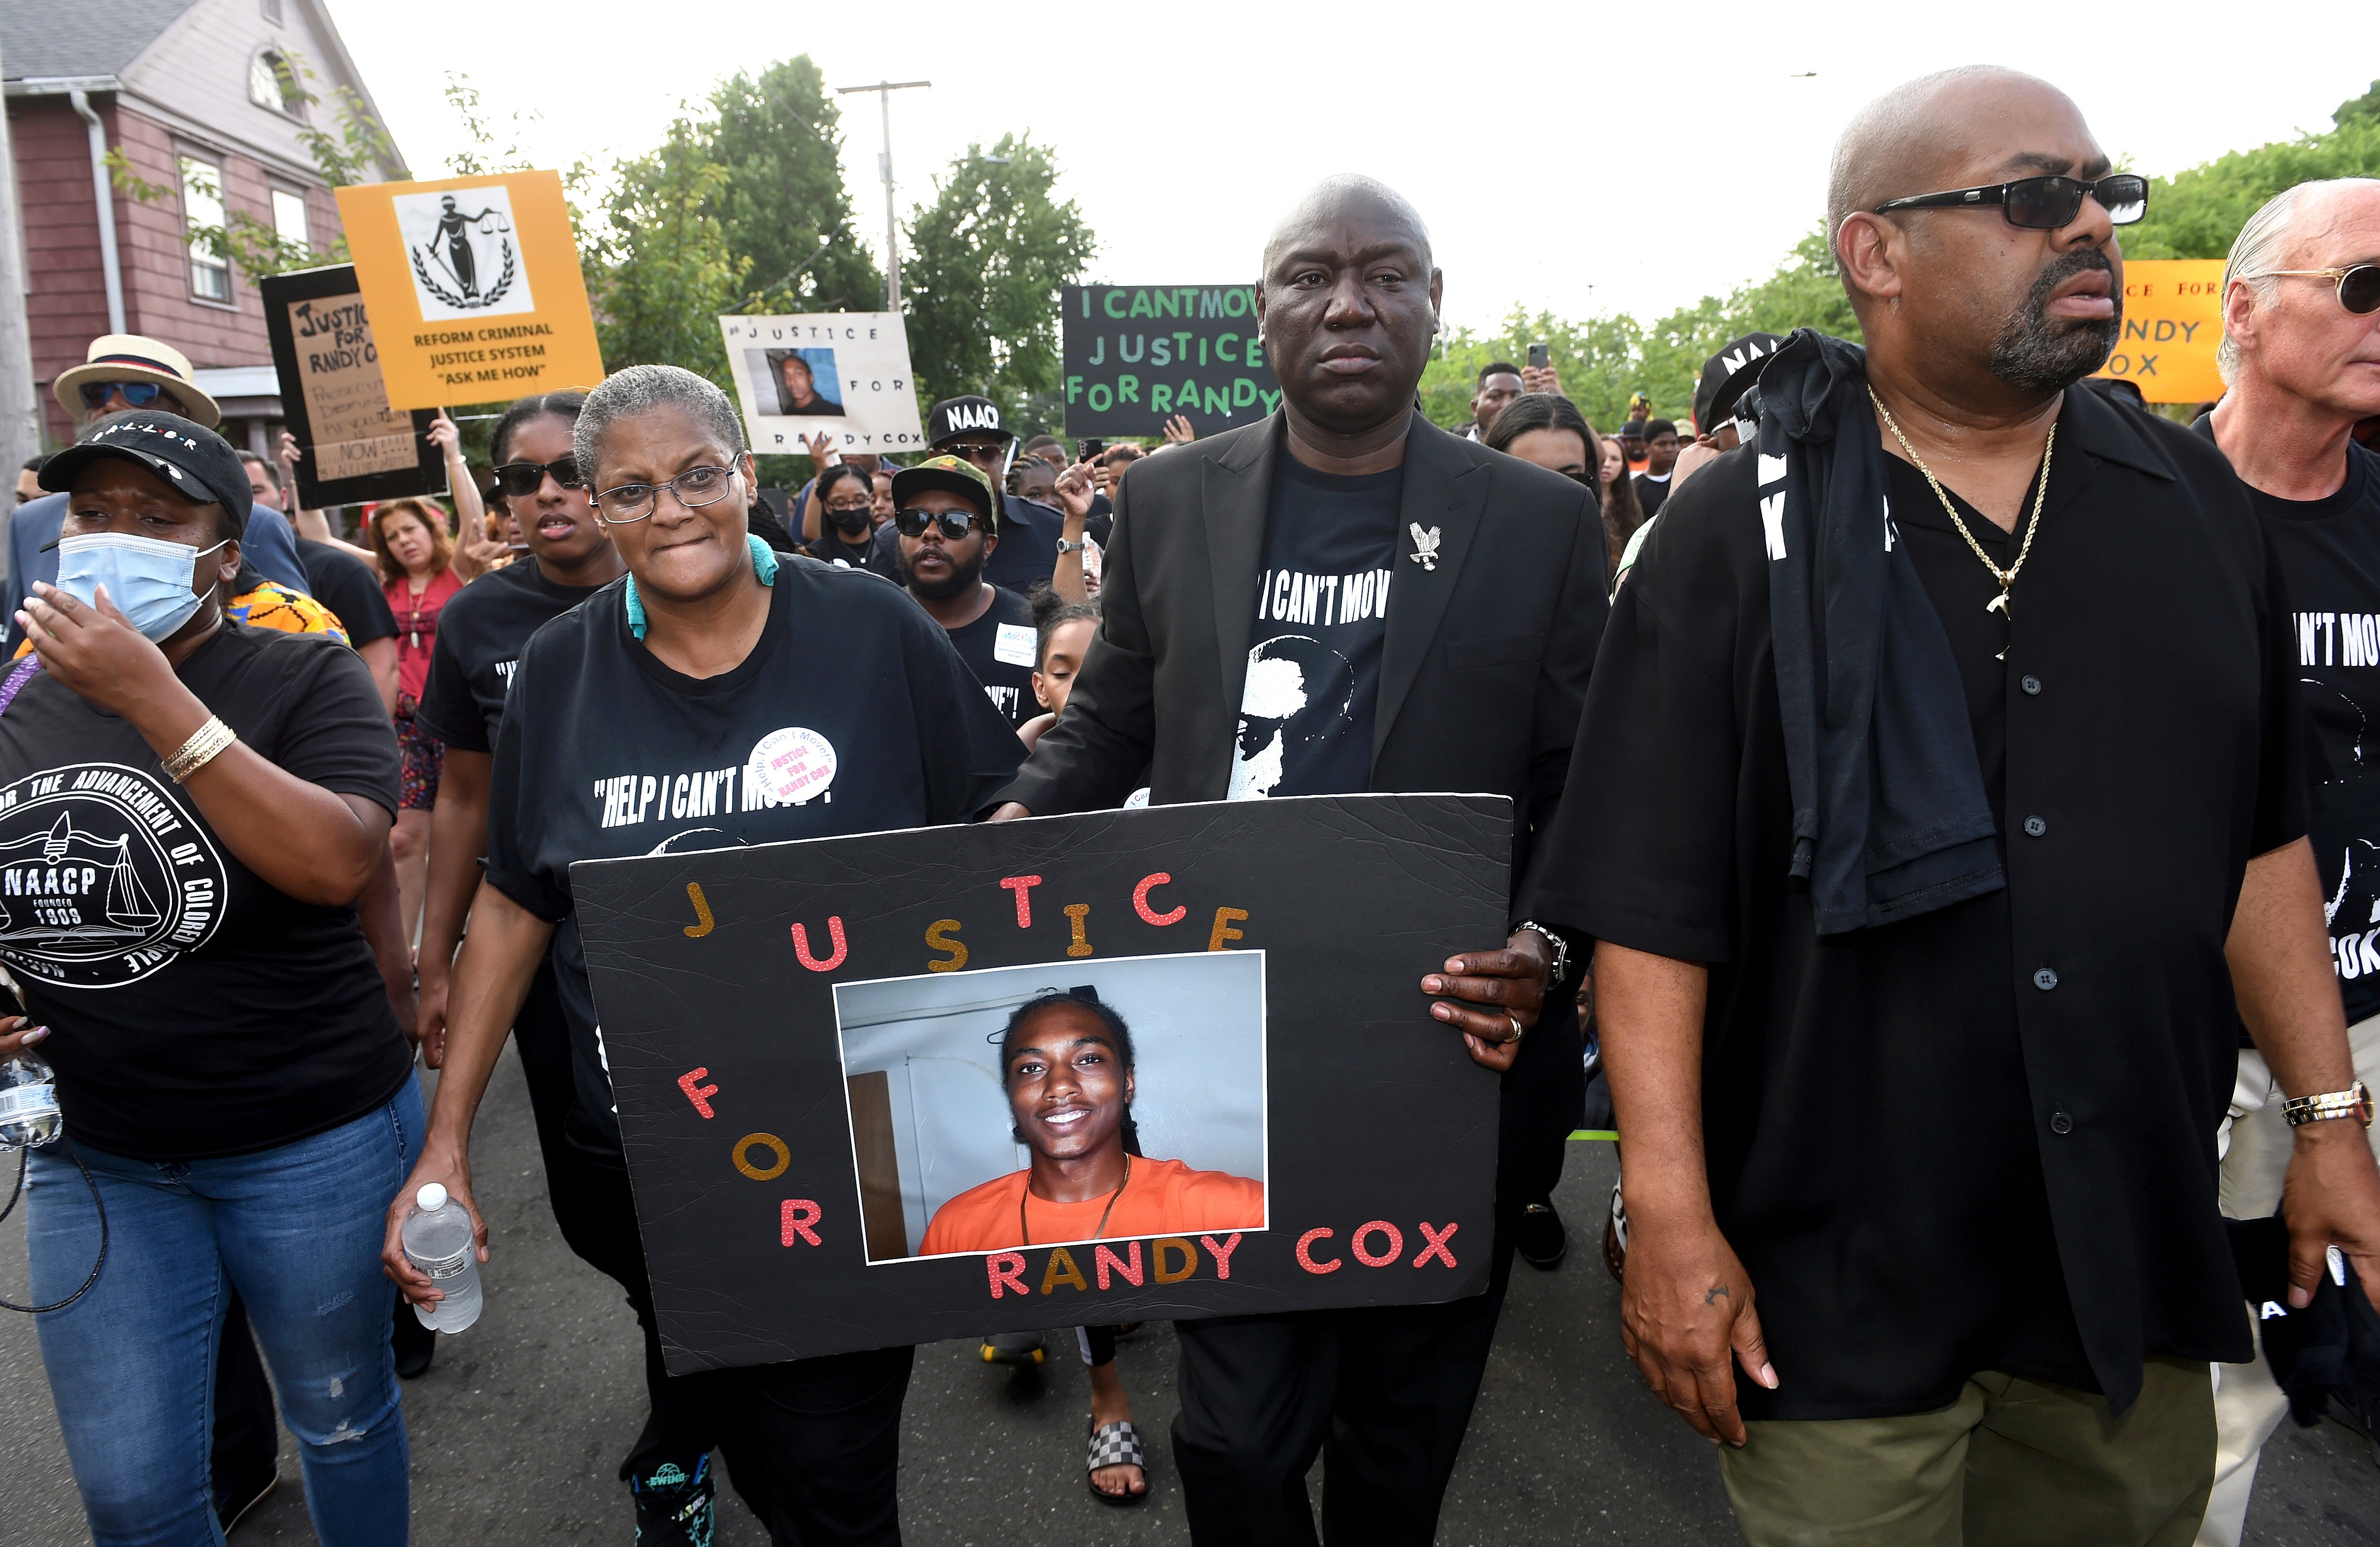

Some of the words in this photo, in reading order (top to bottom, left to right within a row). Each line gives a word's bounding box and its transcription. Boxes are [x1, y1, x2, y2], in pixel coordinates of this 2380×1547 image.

[2178, 282, 2217, 295] FOR
[1082, 290, 1091, 319] I
[334, 327, 365, 348] FOR
[413, 326, 474, 348] REFORM
[477, 323, 554, 341] CRIMINAL
[2125, 319, 2200, 343] NDY
[309, 347, 362, 374] RANDY
[429, 349, 486, 369] JUSTICE
[489, 344, 546, 361] SYSTEM
[1088, 331, 1263, 367] JUSTICE
[438, 369, 473, 386] "ASK
[477, 366, 499, 381] ME
[503, 364, 547, 381] HOW"
[2109, 354, 2159, 376] OX
[850, 380, 904, 391] FOR
[1066, 374, 1139, 412] FOR
[1151, 378, 1281, 416] RANDY
[947, 404, 999, 432] NAACP
[883, 434, 921, 443] COX
[1259, 569, 1272, 620] I
[1272, 568, 1338, 626] CAN'T
[1339, 568, 1394, 625] MOV
[2293, 612, 2336, 667] N'T
[2340, 612, 2380, 667] MO
[763, 730, 796, 750] Can't
[770, 745, 809, 770] JUSTICE
[787, 762, 807, 777] FOR
[31, 773, 64, 798] THE
[778, 774, 810, 797] RANDY
[809, 765, 832, 781] COX
[71, 770, 183, 836] ADVANCEMENT
[594, 774, 656, 828] "HELP
[658, 773, 669, 821] I
[671, 766, 737, 820] CAN'T
[170, 842, 205, 866] OF
[4, 867, 96, 896] NAACP
[33, 898, 72, 908] FOUNDED
[170, 878, 213, 945] COLORED
[34, 908, 82, 925] 1909
[683, 872, 1248, 972] JUSTICE
[677, 1066, 822, 1247] FOR
[986, 1232, 1243, 1299] RANDY
[1295, 1220, 1459, 1275] COX
